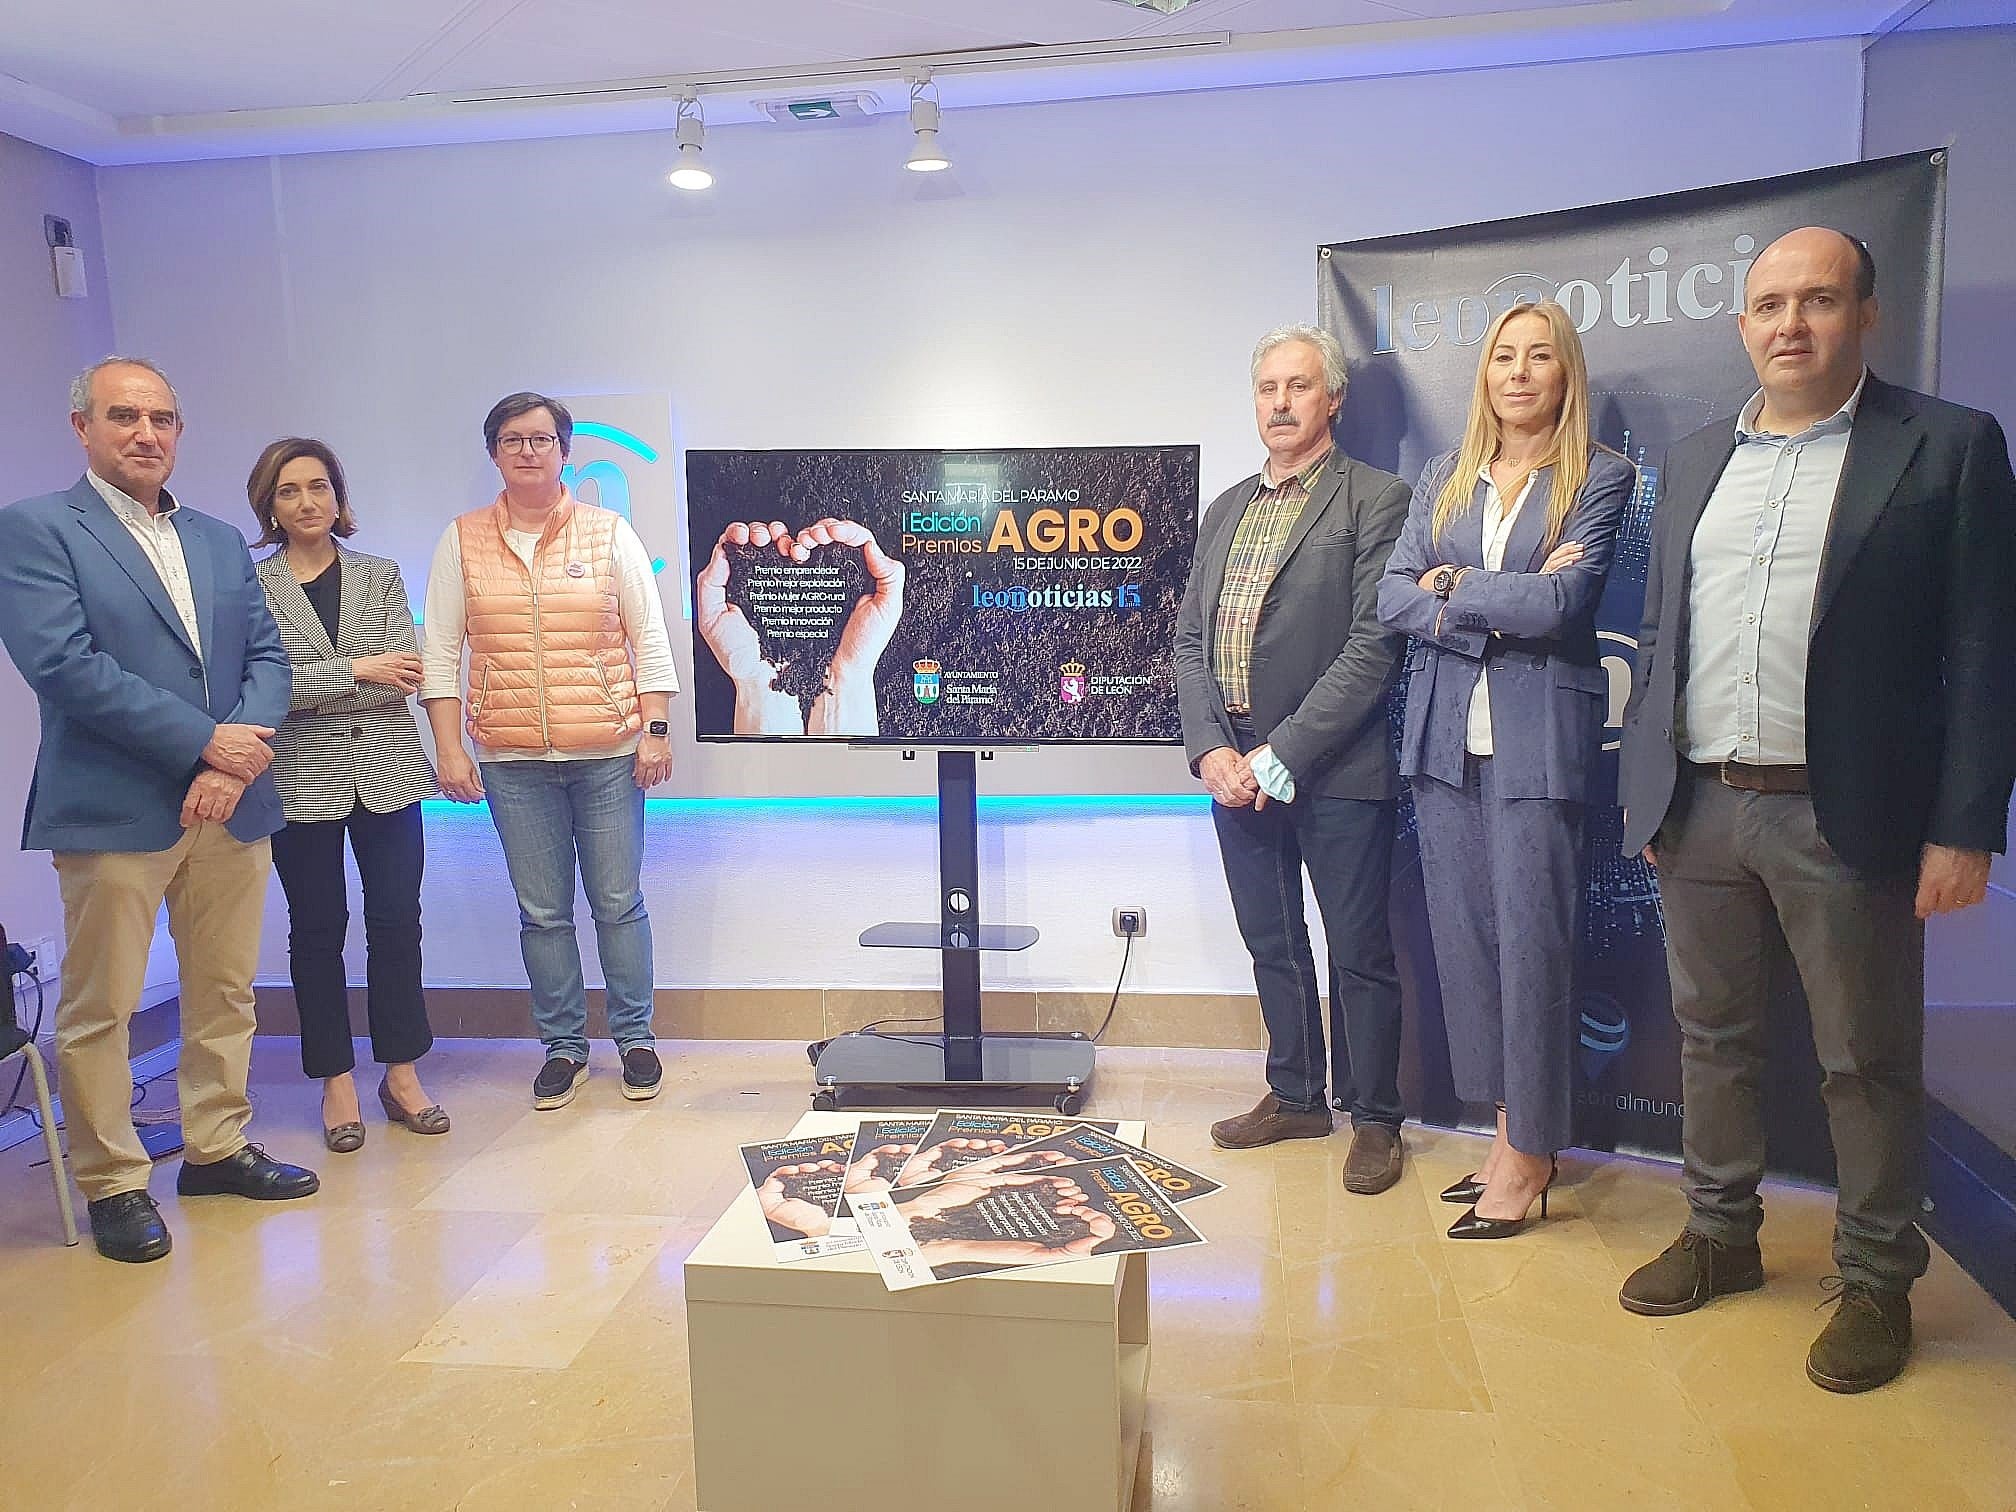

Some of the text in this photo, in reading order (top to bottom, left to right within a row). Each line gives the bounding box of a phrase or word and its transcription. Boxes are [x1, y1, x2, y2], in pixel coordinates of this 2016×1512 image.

[1372, 234, 1755, 358] leootici
[902, 486, 1081, 503] SANTA MARÍA DEL PÁRAMO
[910, 508, 981, 533] Edición
[986, 508, 1144, 553] AGRO
[902, 534, 983, 554] Premios
[1013, 557, 1142, 570] 15 DE JUNIO DE 2022
[755, 565, 840, 576] Premio emprendedor
[747, 578, 775, 587] Premio
[749, 591, 777, 601] Premio
[972, 584, 1113, 611] leonoticias
[753, 604, 781, 613] Premio
[804, 604, 843, 615] producto
[761, 616, 789, 626] Premio
[767, 629, 829, 640] Premio especial
[943, 670, 999, 679] AYUNTAMIENTO
[1090, 673, 1151, 685] DIPUTACIÓN
[946, 683, 997, 694] Santa María
[1090, 684, 1132, 695] DE LEÓN
[946, 693, 994, 705] del Páramo
[1108, 1192, 1173, 1239] AGRO
